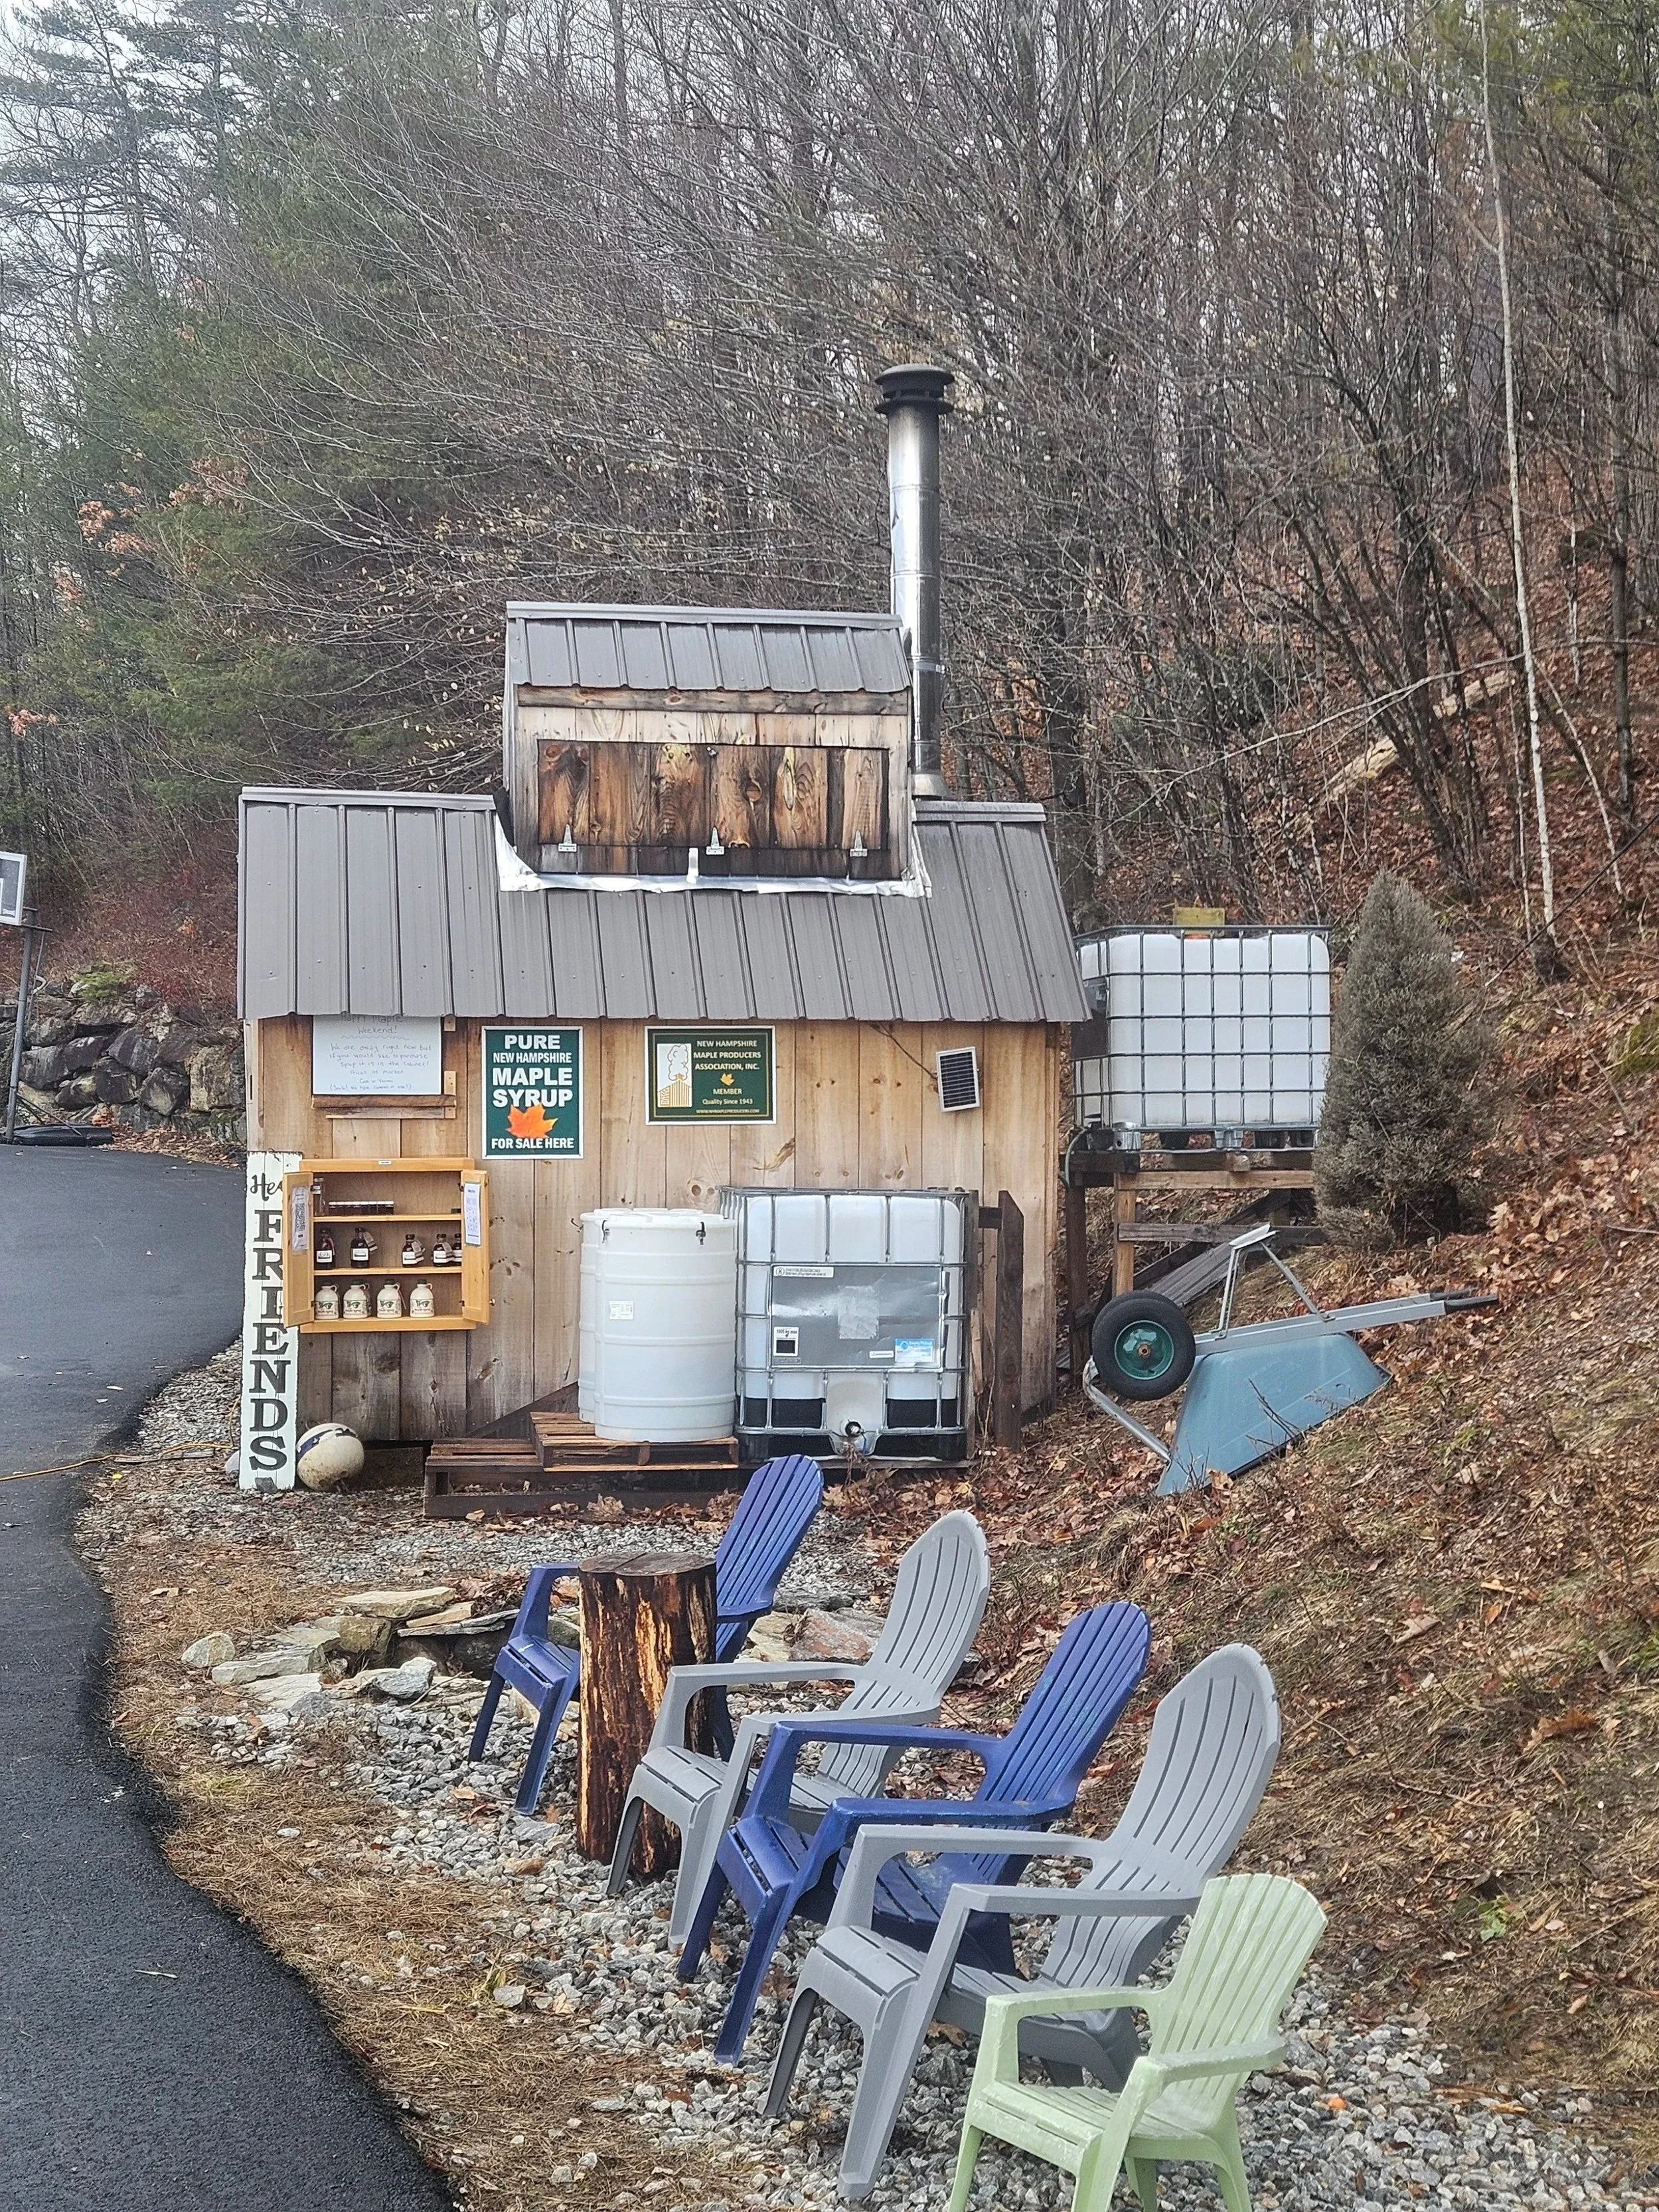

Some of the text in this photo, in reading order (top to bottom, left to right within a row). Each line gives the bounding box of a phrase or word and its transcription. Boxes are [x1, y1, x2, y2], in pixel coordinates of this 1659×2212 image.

[358, 1025, 397, 1034] Weekend!
[505, 1035, 560, 1049] PURE
[331, 1043, 341, 1051] We
[359, 1045, 378, 1055] away
[382, 1044, 400, 1054] right
[493, 1053, 572, 1063] NEW HAMPSHIRE
[493, 1068, 573, 1086] MAPLE
[493, 1089, 573, 1107] SYRUP
[491, 1138, 574, 1149] FOR SALE HERE
[248, 1209, 291, 1471] FRIENDS
